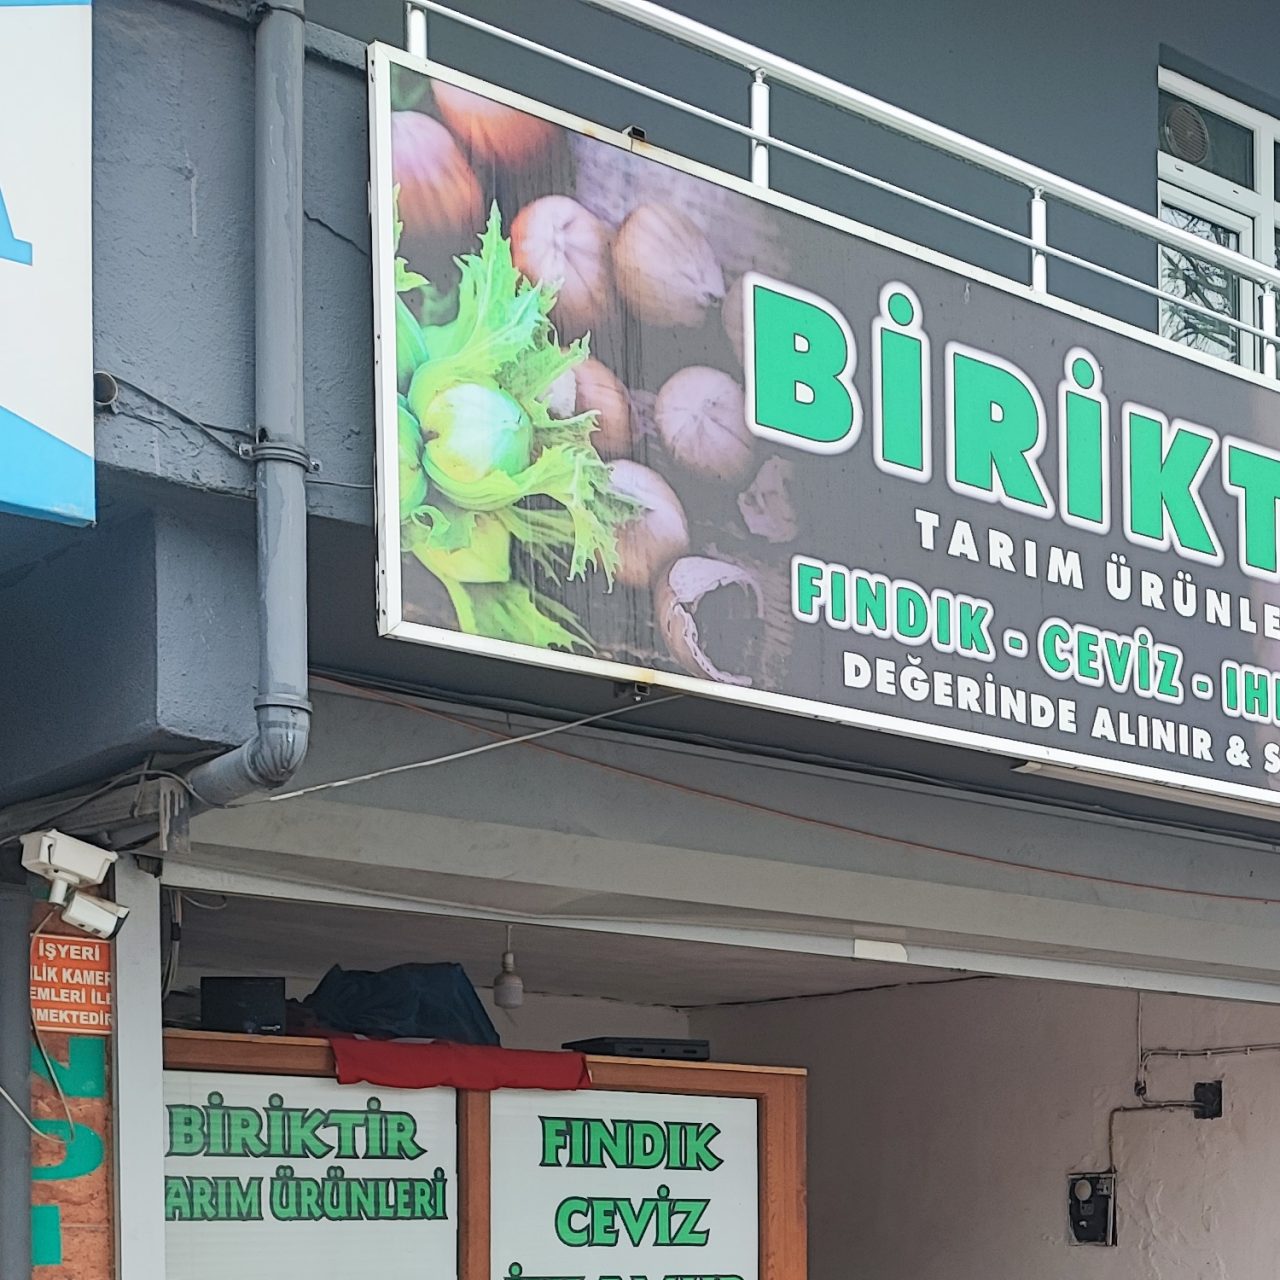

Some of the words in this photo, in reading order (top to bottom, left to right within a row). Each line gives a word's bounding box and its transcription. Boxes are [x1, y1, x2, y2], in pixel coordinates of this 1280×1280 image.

[914, 510, 1084, 590] TARIM
[795, 558, 993, 658] FINDIK
[1041, 620, 1181, 702] CEVİZ
[843, 650, 1077, 734] DEĞERİNDE
[1091, 706, 1214, 762] ALINIR
[1225, 735, 1252, 769] &
[38, 939, 100, 961] İŞYERİ
[164, 1090, 428, 1160] BİRİKTİR
[538, 1115, 724, 1171] FINDIK
[164, 1175, 264, 1221] ARIM
[270, 1165, 448, 1221] ÜRÜNLERİ
[554, 1184, 711, 1247] CEVİZ
